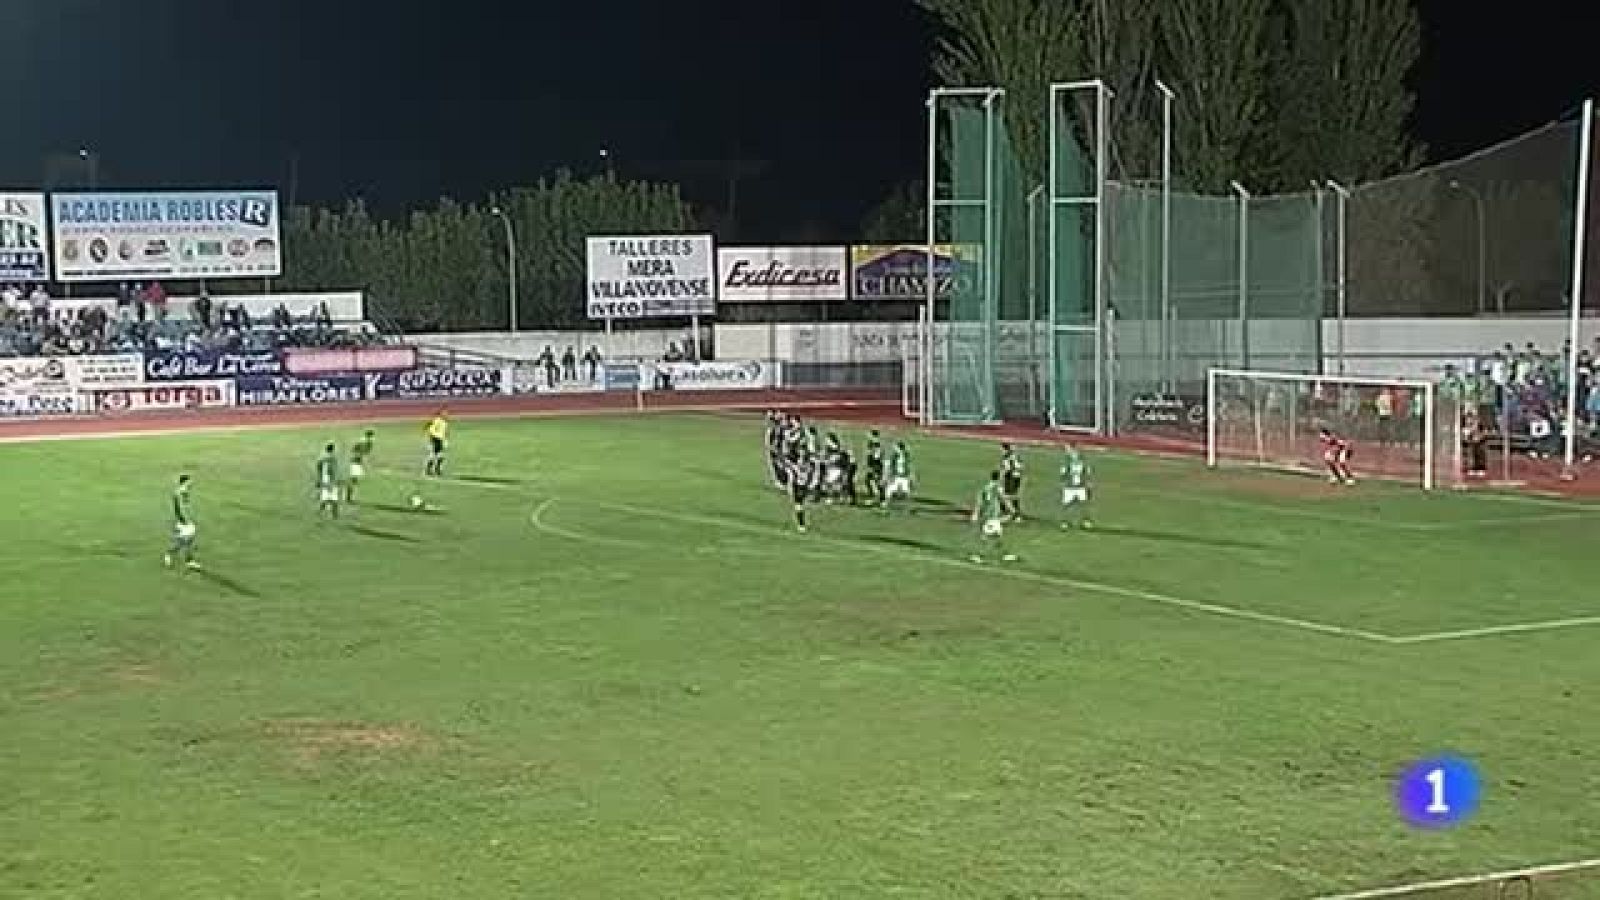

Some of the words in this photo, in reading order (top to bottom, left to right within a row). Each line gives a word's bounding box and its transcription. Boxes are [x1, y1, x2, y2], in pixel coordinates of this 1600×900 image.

[60, 201, 163, 223] ACADEMIA
[167, 199, 238, 222] ROBLES
[608, 239, 692, 256] TALLERES
[627, 259, 674, 276] MERA
[725, 260, 840, 288] Exdicesa
[592, 279, 709, 297] VILLANOVENSE
[240, 386, 360, 404] MIRAFLORES
